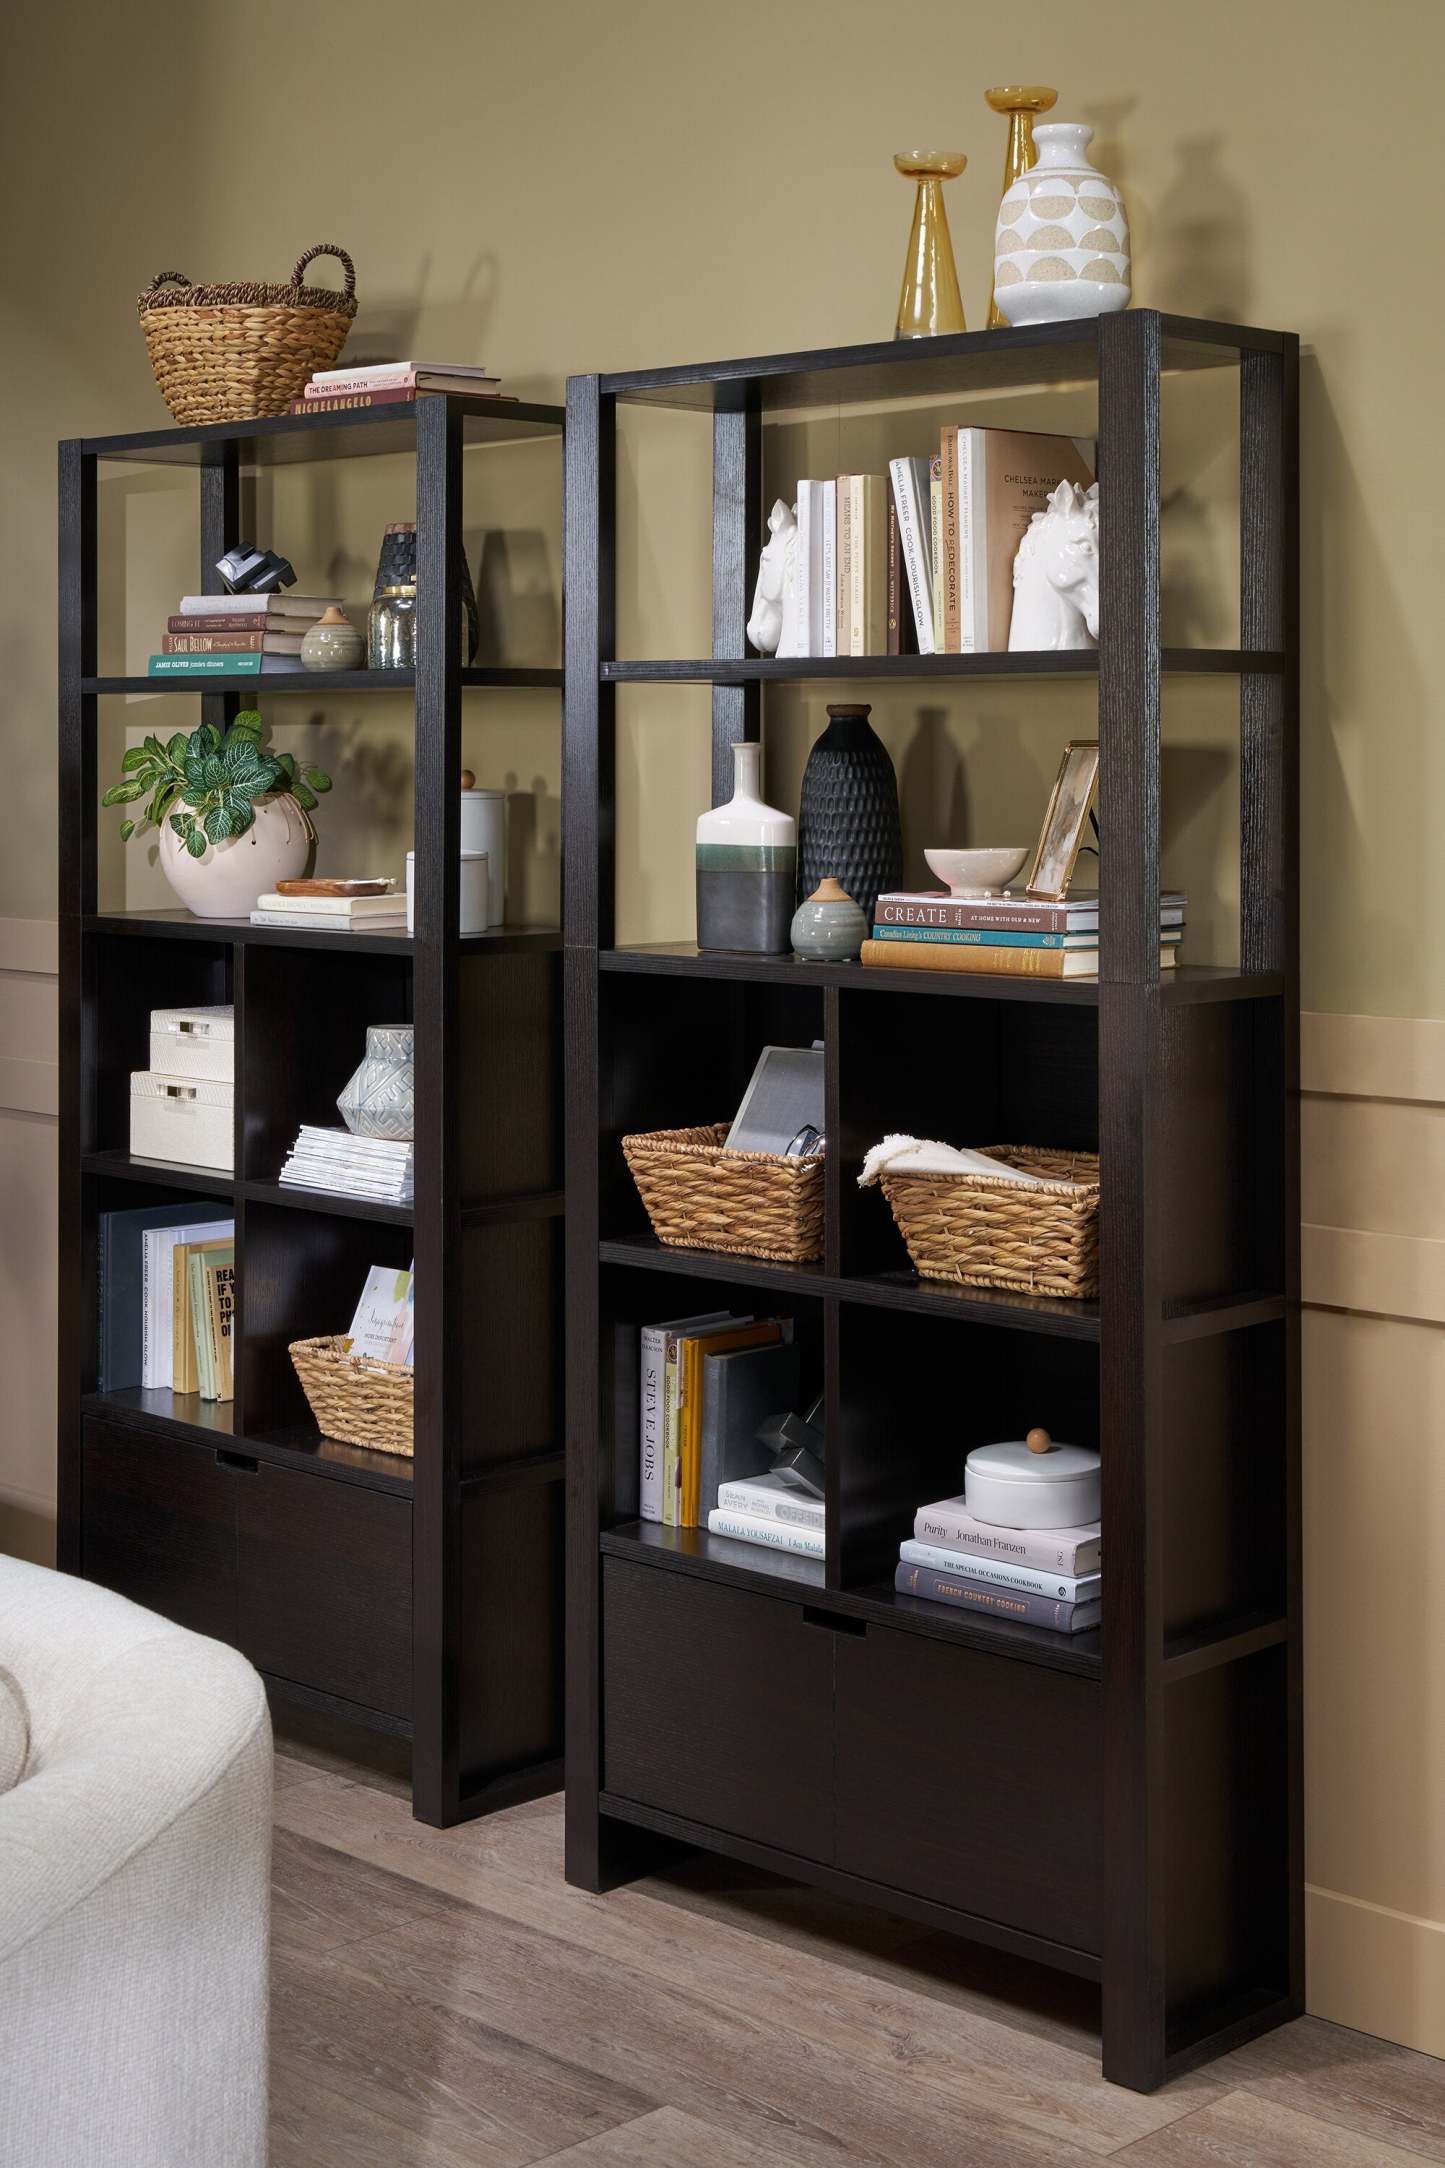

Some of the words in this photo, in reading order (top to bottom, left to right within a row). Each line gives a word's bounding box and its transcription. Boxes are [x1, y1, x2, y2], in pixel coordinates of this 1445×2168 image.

[320, 383, 352, 393] DREAMING
[353, 381, 368, 389] PATH
[294, 395, 372, 415] MICHELANGELO
[1004, 474, 1037, 484] CHELSEA
[896, 461, 905, 493] AMELIA
[901, 495, 910, 522] FREER
[947, 493, 955, 519] HOW
[948, 522, 955, 536] TO
[190, 636, 213, 653] BELLOW
[884, 906, 947, 923] CREATE
[216, 1269, 234, 1282] REA
[217, 1284, 227, 1296] IF
[219, 1296, 231, 1309] TO
[645, 1368, 656, 1431] STEVE
[644, 1435, 655, 1481] JOBS
[718, 1521, 745, 1536] MALALA
[747, 1528, 783, 1544] YOUSAFZAI
[804, 1542, 824, 1553] Malala
[924, 1522, 947, 1538] Purity
[956, 1529, 993, 1547] Jonathan
[993, 1537, 1026, 1555] Franzen
[955, 1564, 978, 1574] SPECIAL
[978, 1569, 1010, 1582] OCCASIONS
[1010, 1577, 1043, 1590] COOKBOOK
